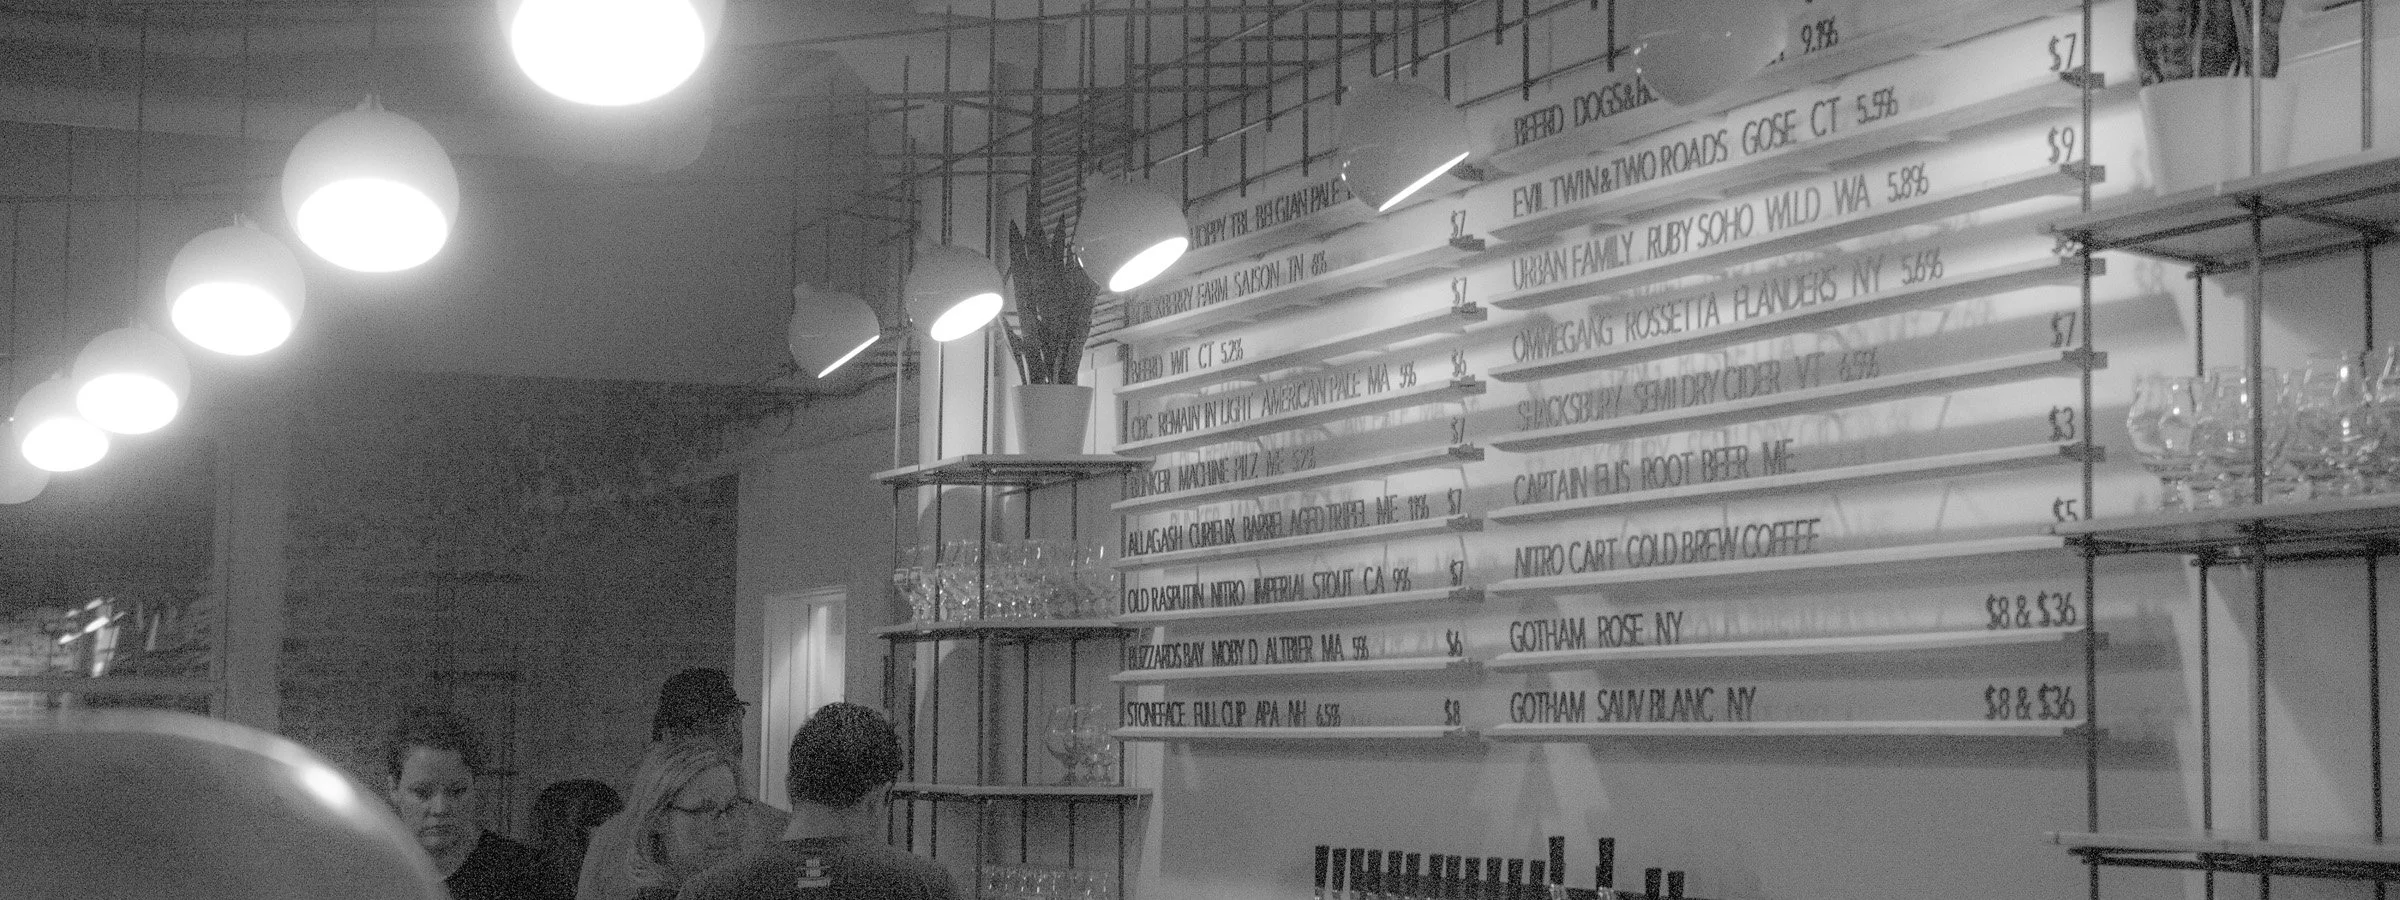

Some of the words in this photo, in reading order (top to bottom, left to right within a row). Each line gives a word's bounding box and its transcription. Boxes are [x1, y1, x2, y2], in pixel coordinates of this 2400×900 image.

[1801, 16, 1838, 54] 9.1%
[1513, 182, 1547, 219] EVIL
[1660, 129, 1728, 177] ROADS
[1742, 109, 1797, 156] GOSE
[1811, 96, 1841, 137] CT
[1857, 85, 1898, 124] 5.5%
[2049, 33, 2076, 72] $7
[1256, 188, 1308, 230] BELGIAN
[1309, 178, 1342, 214] PALE
[1512, 248, 1567, 290] URBAN
[1572, 231, 1634, 278] FAMILY
[1647, 217, 1693, 261] RUBY
[1698, 202, 1753, 248] SOHO
[1766, 187, 1821, 232] WILD
[1833, 173, 1870, 216] WA
[1887, 162, 1929, 203] 5.8%
[2048, 126, 2074, 164] $9
[1197, 275, 1229, 308] FARM
[1234, 260, 1280, 297] SAISON
[1287, 253, 1304, 284] TN
[1451, 209, 1466, 238] $7
[1171, 347, 1191, 375] WIT
[1199, 341, 1214, 369] CT
[1451, 276, 1467, 306] $7
[1513, 315, 1613, 363] OMMEGANG
[1626, 291, 1720, 343] ROSSETTA
[1733, 265, 1837, 321] FLANDERS
[1852, 253, 1886, 297] NY
[1158, 405, 1200, 437] REMAIN
[1205, 400, 1217, 428] IN
[1220, 392, 1254, 425] LIGHT
[1261, 377, 1326, 417] AMERICAN
[1330, 369, 1362, 403] PALE
[1368, 363, 1391, 395] MA
[1399, 360, 1417, 388] 5%
[1451, 349, 1467, 378] $6
[1633, 376, 1677, 414] SEMI
[1682, 368, 1721, 408] DRY
[1722, 359, 1781, 401] CIDER
[1795, 352, 1826, 389] VT
[2050, 311, 2076, 348] $7
[1178, 456, 1230, 491] MACHINE
[1266, 446, 1285, 478] ME
[1451, 416, 1466, 444] $7
[1513, 465, 1588, 506] CAPTAIN
[1641, 451, 1695, 491] ROOT
[1701, 444, 1748, 483] BEER
[1762, 437, 1794, 475] ME
[2049, 405, 2076, 442] $3
[1127, 525, 1184, 557] ALLAGASH
[1188, 517, 1237, 549] CURIEUX
[1243, 510, 1285, 542] BARREL
[1290, 505, 1325, 536] AGED
[1326, 498, 1370, 532] TRIPEL
[1376, 494, 1399, 525] ME
[1407, 493, 1430, 521] 11%
[1447, 487, 1462, 515] $7
[1514, 543, 1565, 580] NITRO
[1569, 537, 1619, 575] CART
[1626, 531, 1678, 568] COLD
[1681, 525, 1741, 566] BREW
[1742, 517, 1822, 558] COFFEE
[2052, 495, 2078, 523] $5
[1127, 588, 1150, 614] OLD
[1151, 582, 1204, 612] RASPUTIN
[1210, 579, 1246, 608] NITRO
[1254, 573, 1309, 605] IMPERIAL
[1312, 568, 1354, 600] STOUT
[1363, 565, 1385, 595] CA
[1392, 566, 1412, 592] 9%
[1450, 558, 1465, 587] $7
[1509, 617, 1586, 652] GOTHAM
[1597, 612, 1644, 648] ROSE
[1655, 610, 1684, 645] NY
[1985, 593, 2010, 631] $8
[2016, 594, 2032, 629] &
[2037, 589, 2076, 627] $36
[1128, 641, 1182, 670] BUZZARDS
[1183, 640, 1205, 668] BAY
[1211, 638, 1246, 667] MOBY
[1248, 638, 1259, 665] D
[1320, 633, 1345, 662] MA
[1352, 634, 1370, 661] 5%
[1446, 628, 1463, 658] $6
[1127, 701, 1186, 728] STONEFACE
[1193, 701, 1221, 728] FULL
[1255, 699, 1280, 728] APA
[1287, 699, 1308, 728] NH
[1444, 698, 1461, 727] $8
[1509, 690, 1586, 723] GOTHAM
[1597, 689, 1646, 723] SAUV
[1649, 686, 1715, 722] BLANC
[1727, 686, 1758, 722] NY
[1984, 684, 2010, 721] $8
[2016, 686, 2032, 721] &
[2037, 683, 2076, 721] $36
